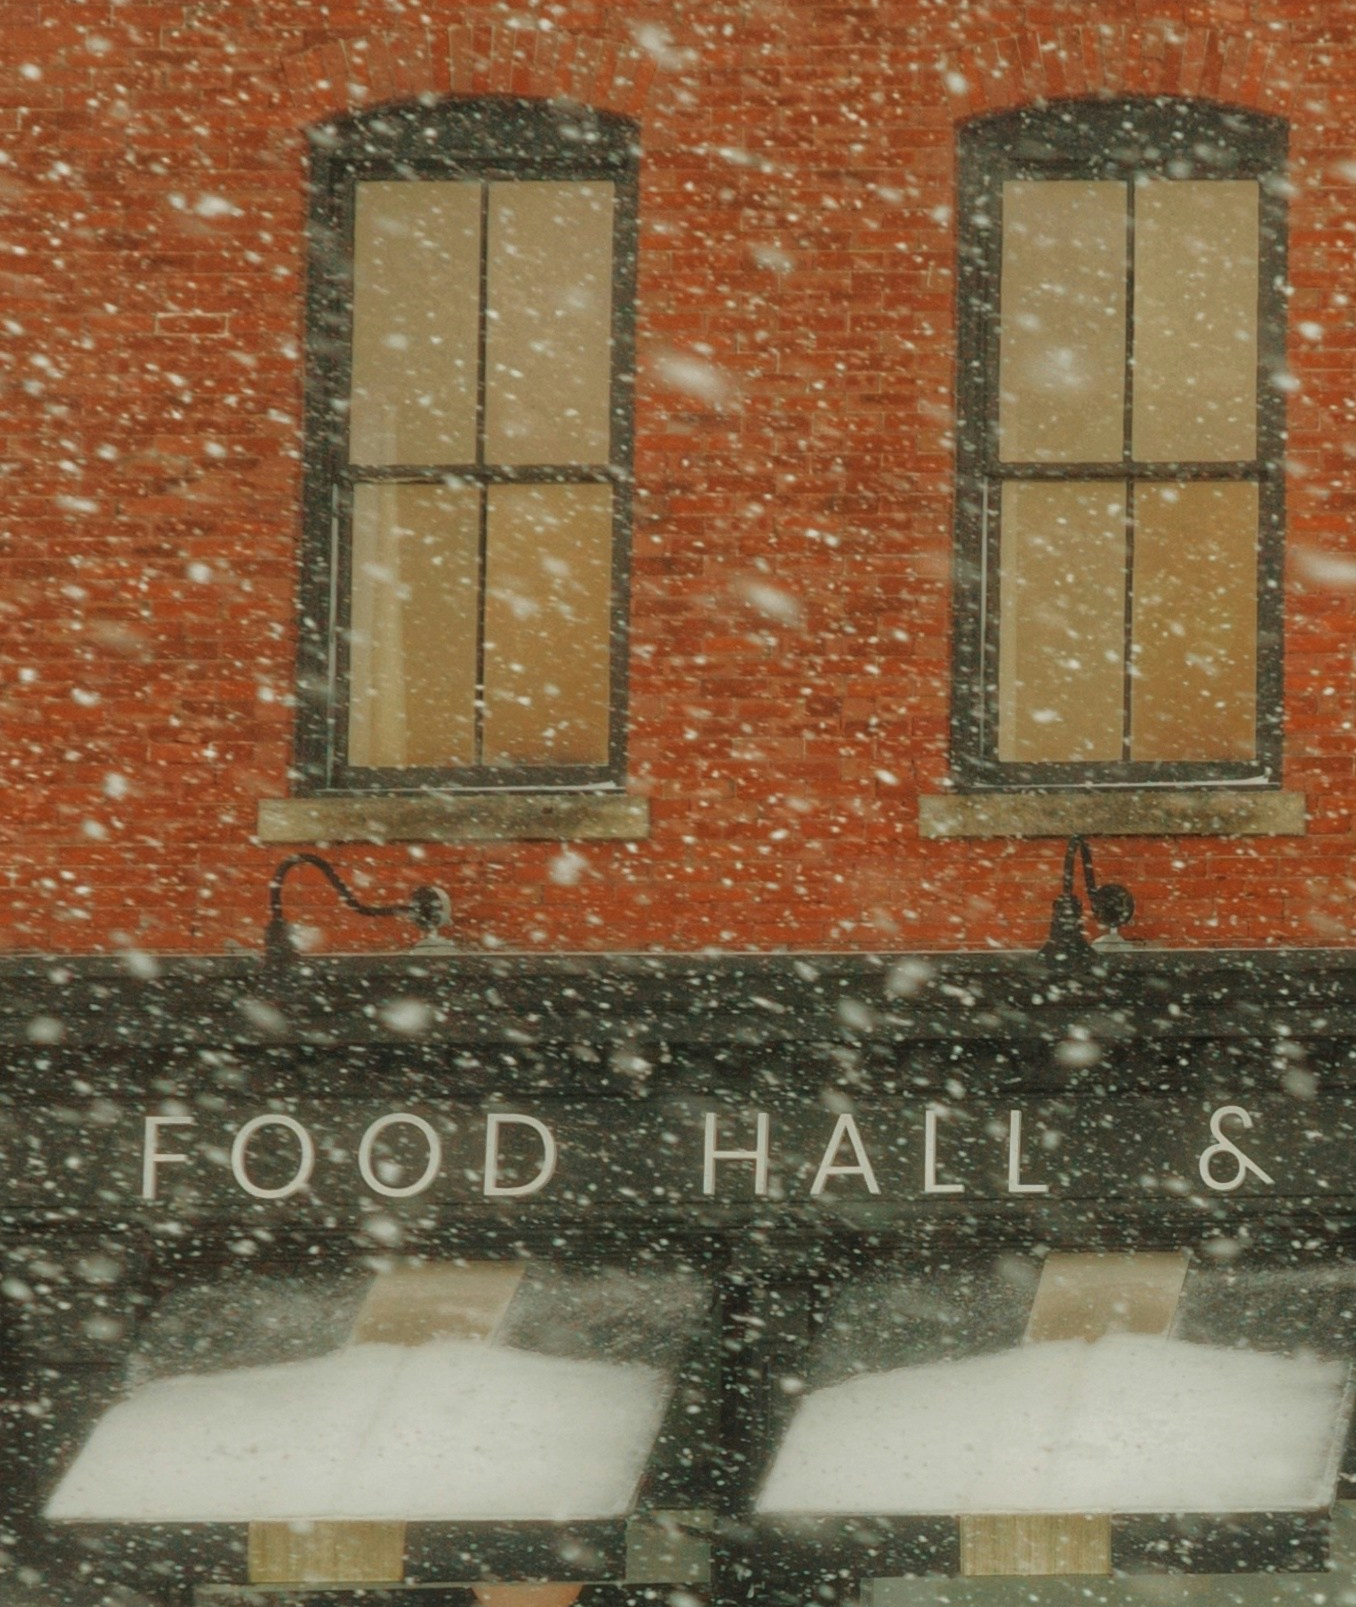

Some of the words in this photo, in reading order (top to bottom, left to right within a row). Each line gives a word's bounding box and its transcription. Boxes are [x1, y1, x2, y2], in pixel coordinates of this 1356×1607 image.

[142, 1113, 557, 1199] FOOD
[701, 1110, 1050, 1193] HALL
[1199, 1105, 1274, 1191] &
